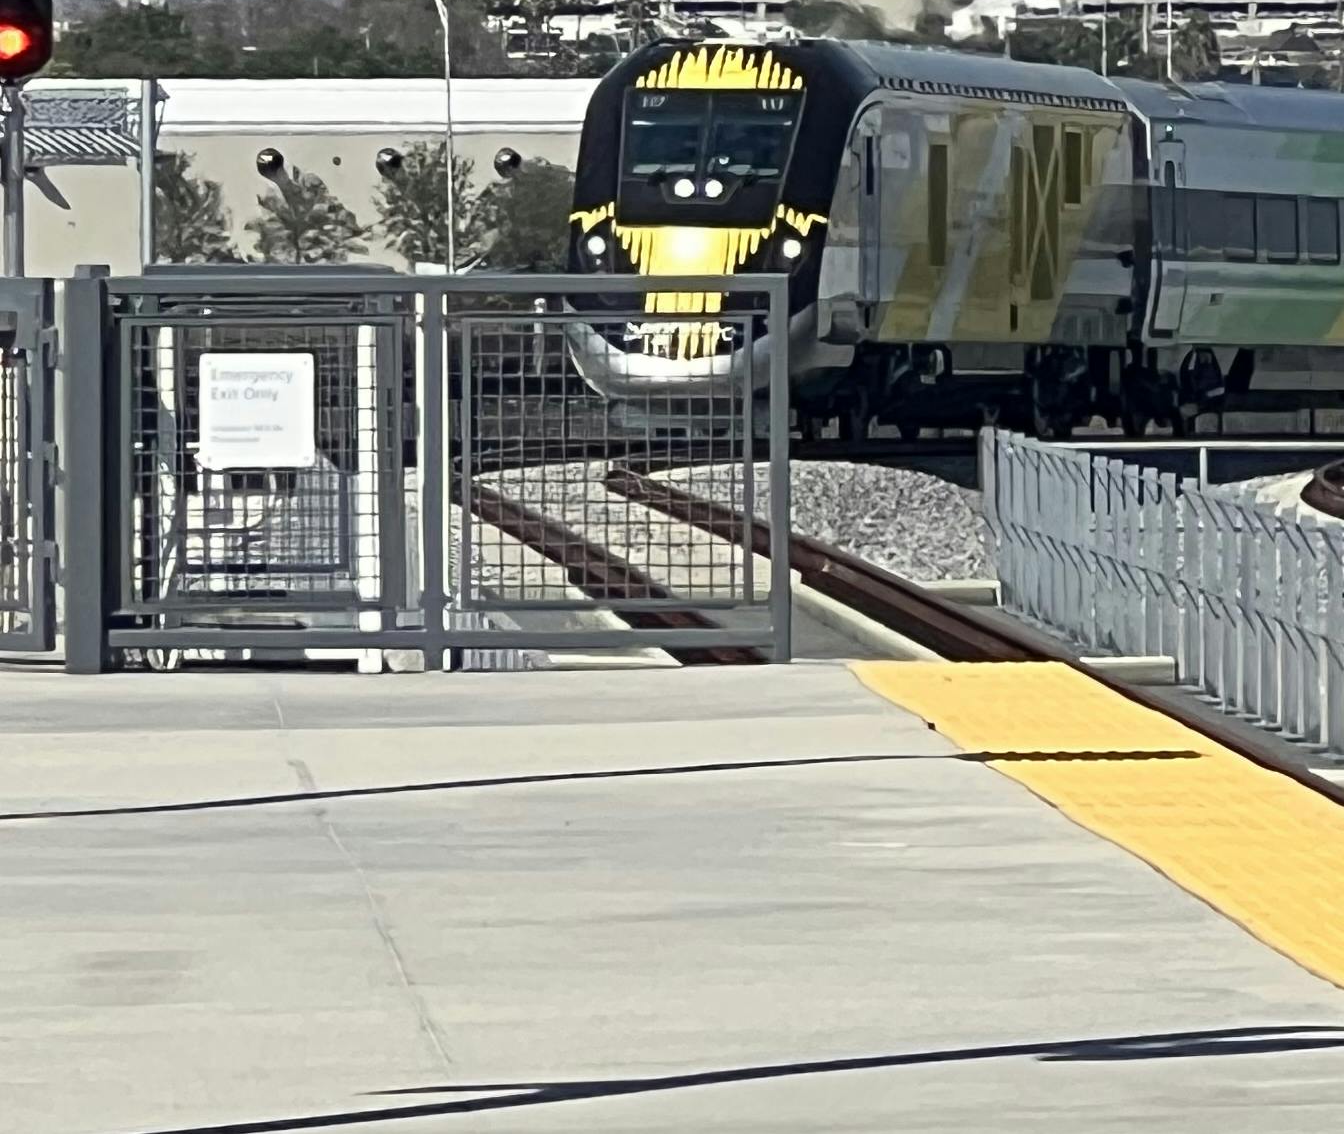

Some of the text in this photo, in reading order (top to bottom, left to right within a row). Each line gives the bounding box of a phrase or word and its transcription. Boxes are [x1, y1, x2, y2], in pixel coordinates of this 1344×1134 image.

[210, 368, 294, 384] Emergency
[210, 387, 279, 402] Exit Only
